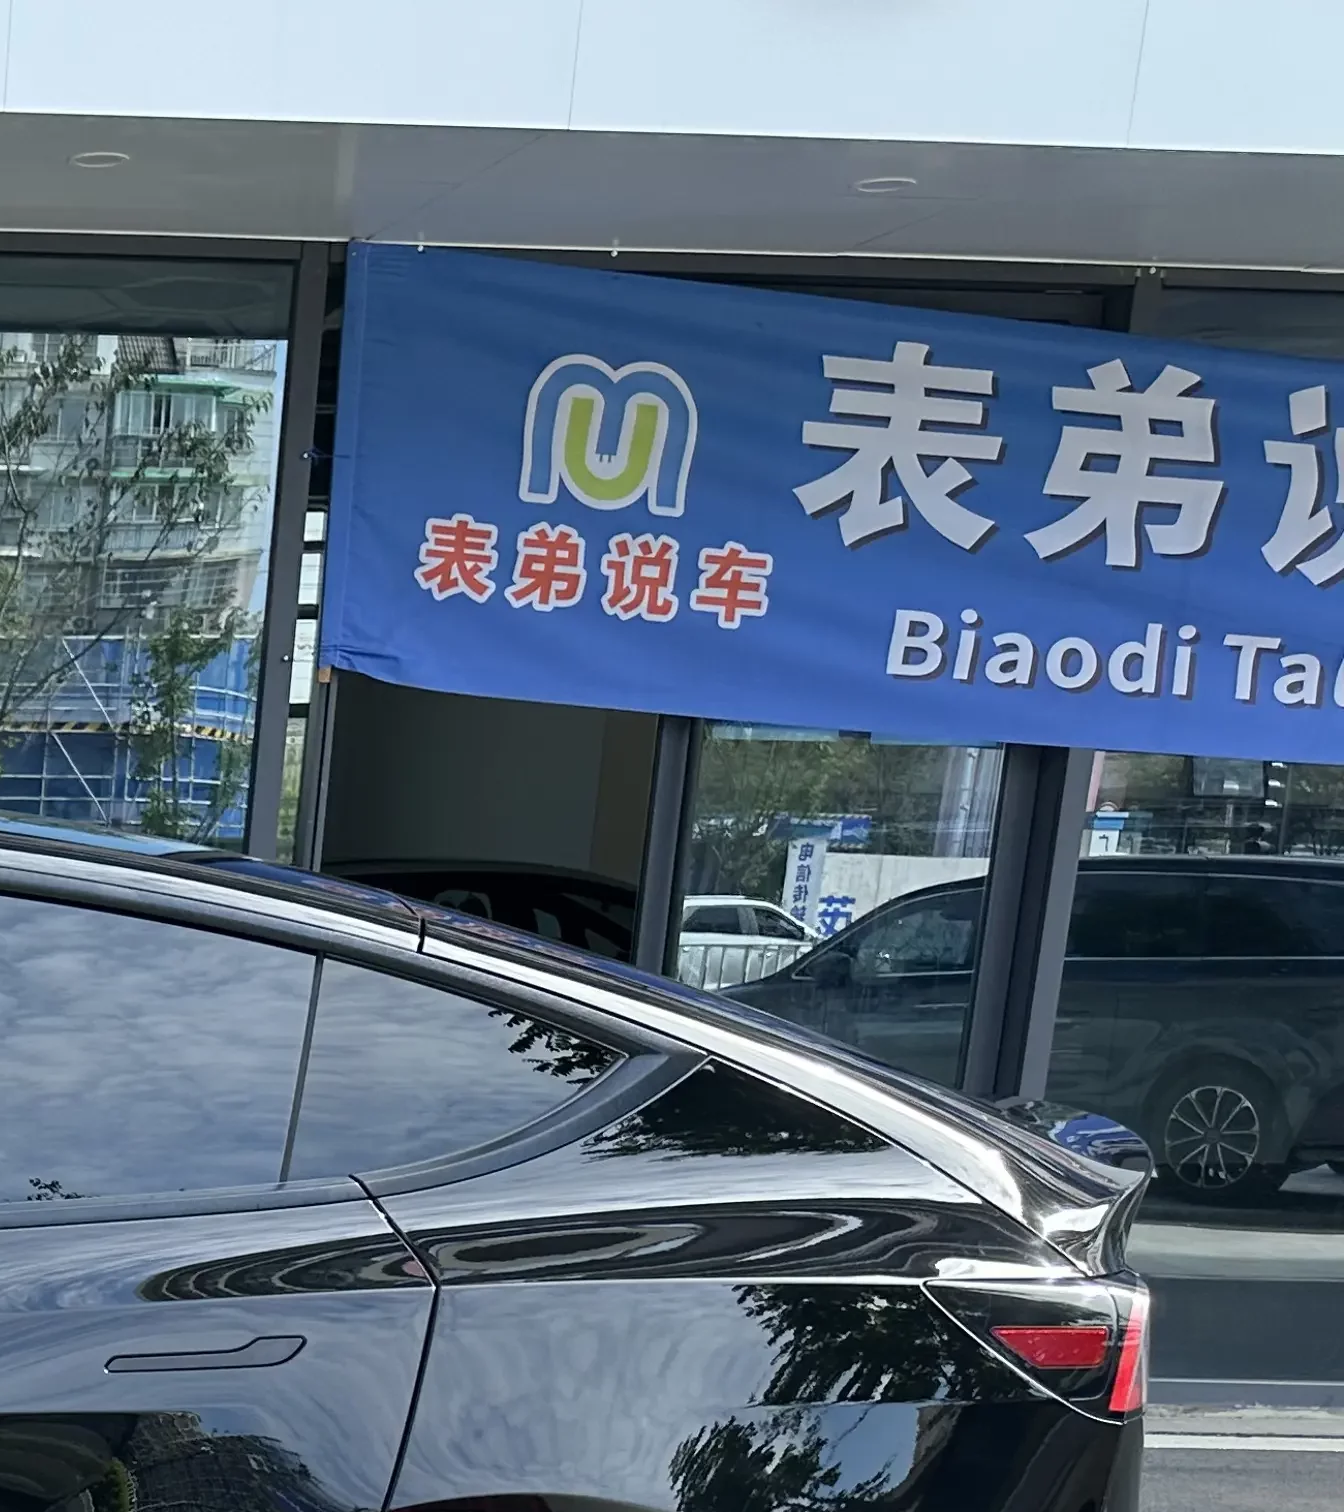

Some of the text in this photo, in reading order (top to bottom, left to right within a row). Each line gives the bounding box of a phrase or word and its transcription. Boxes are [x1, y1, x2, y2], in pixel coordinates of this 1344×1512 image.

[415, 514, 773, 628] 表弟说车
[885, 608, 1198, 696] Biaodi
